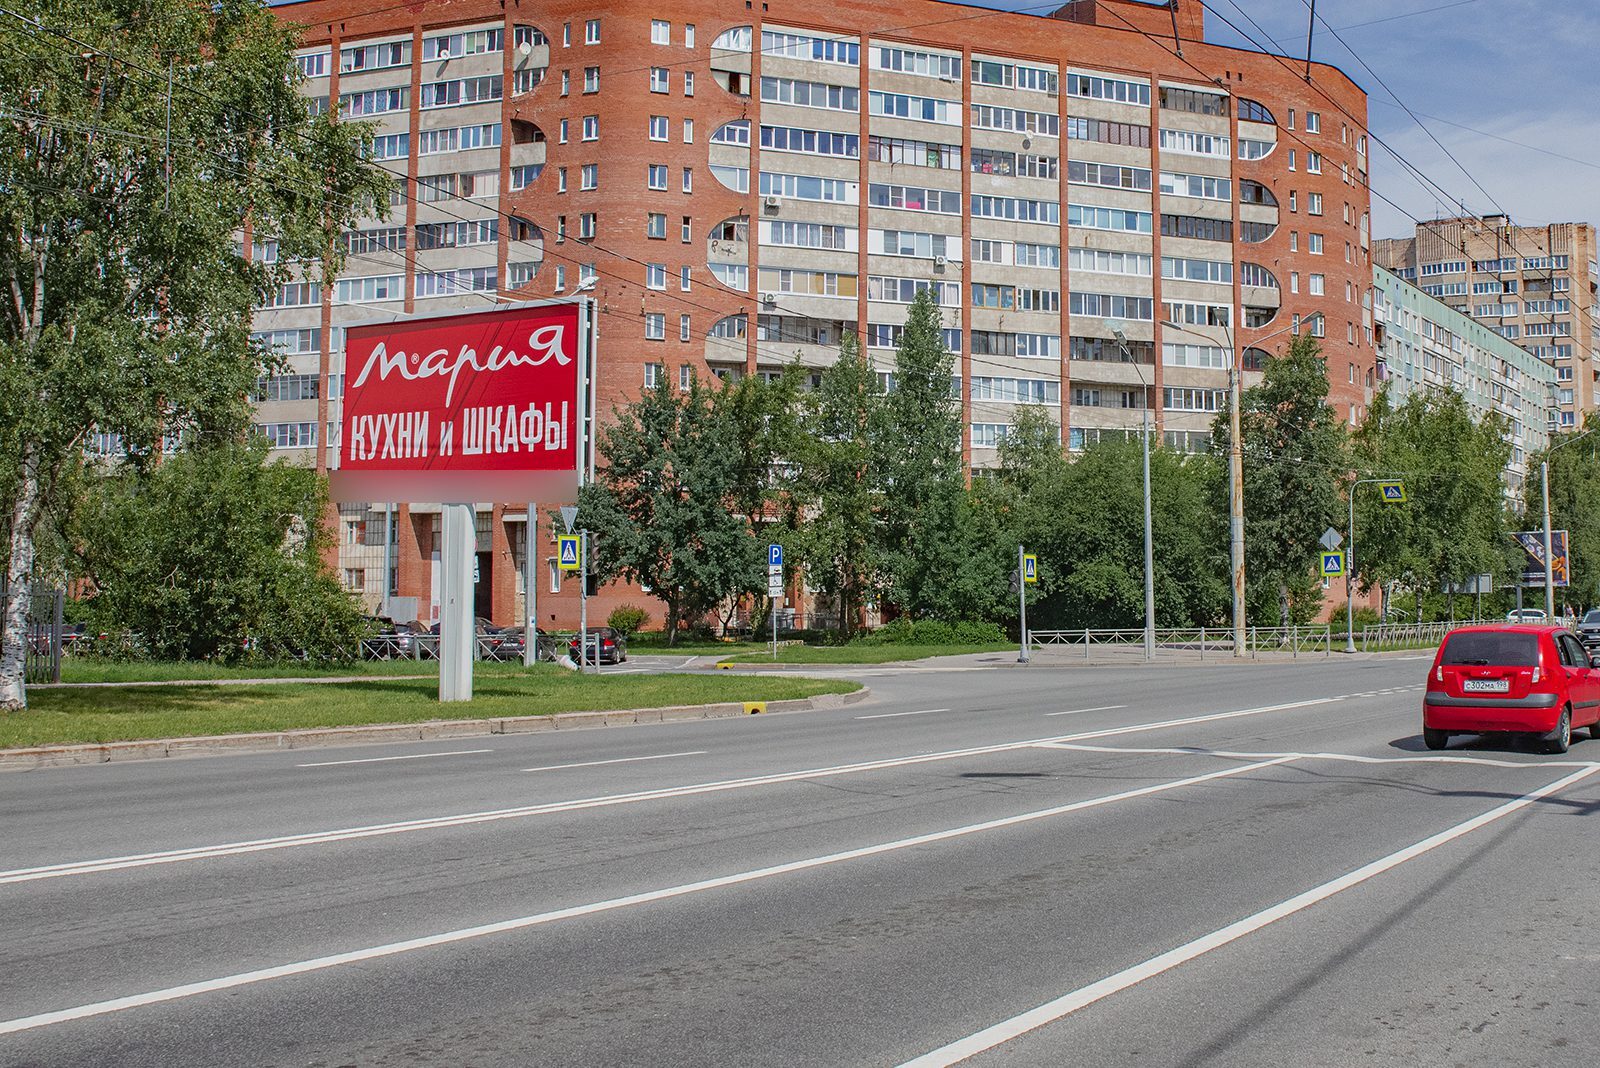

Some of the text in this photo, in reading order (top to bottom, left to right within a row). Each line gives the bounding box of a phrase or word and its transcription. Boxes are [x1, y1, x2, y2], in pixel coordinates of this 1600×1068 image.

[352, 325, 572, 408] Мария
[350, 401, 568, 461] КУХНИ и ШКАФЫ
[772, 547, 780, 563] P
